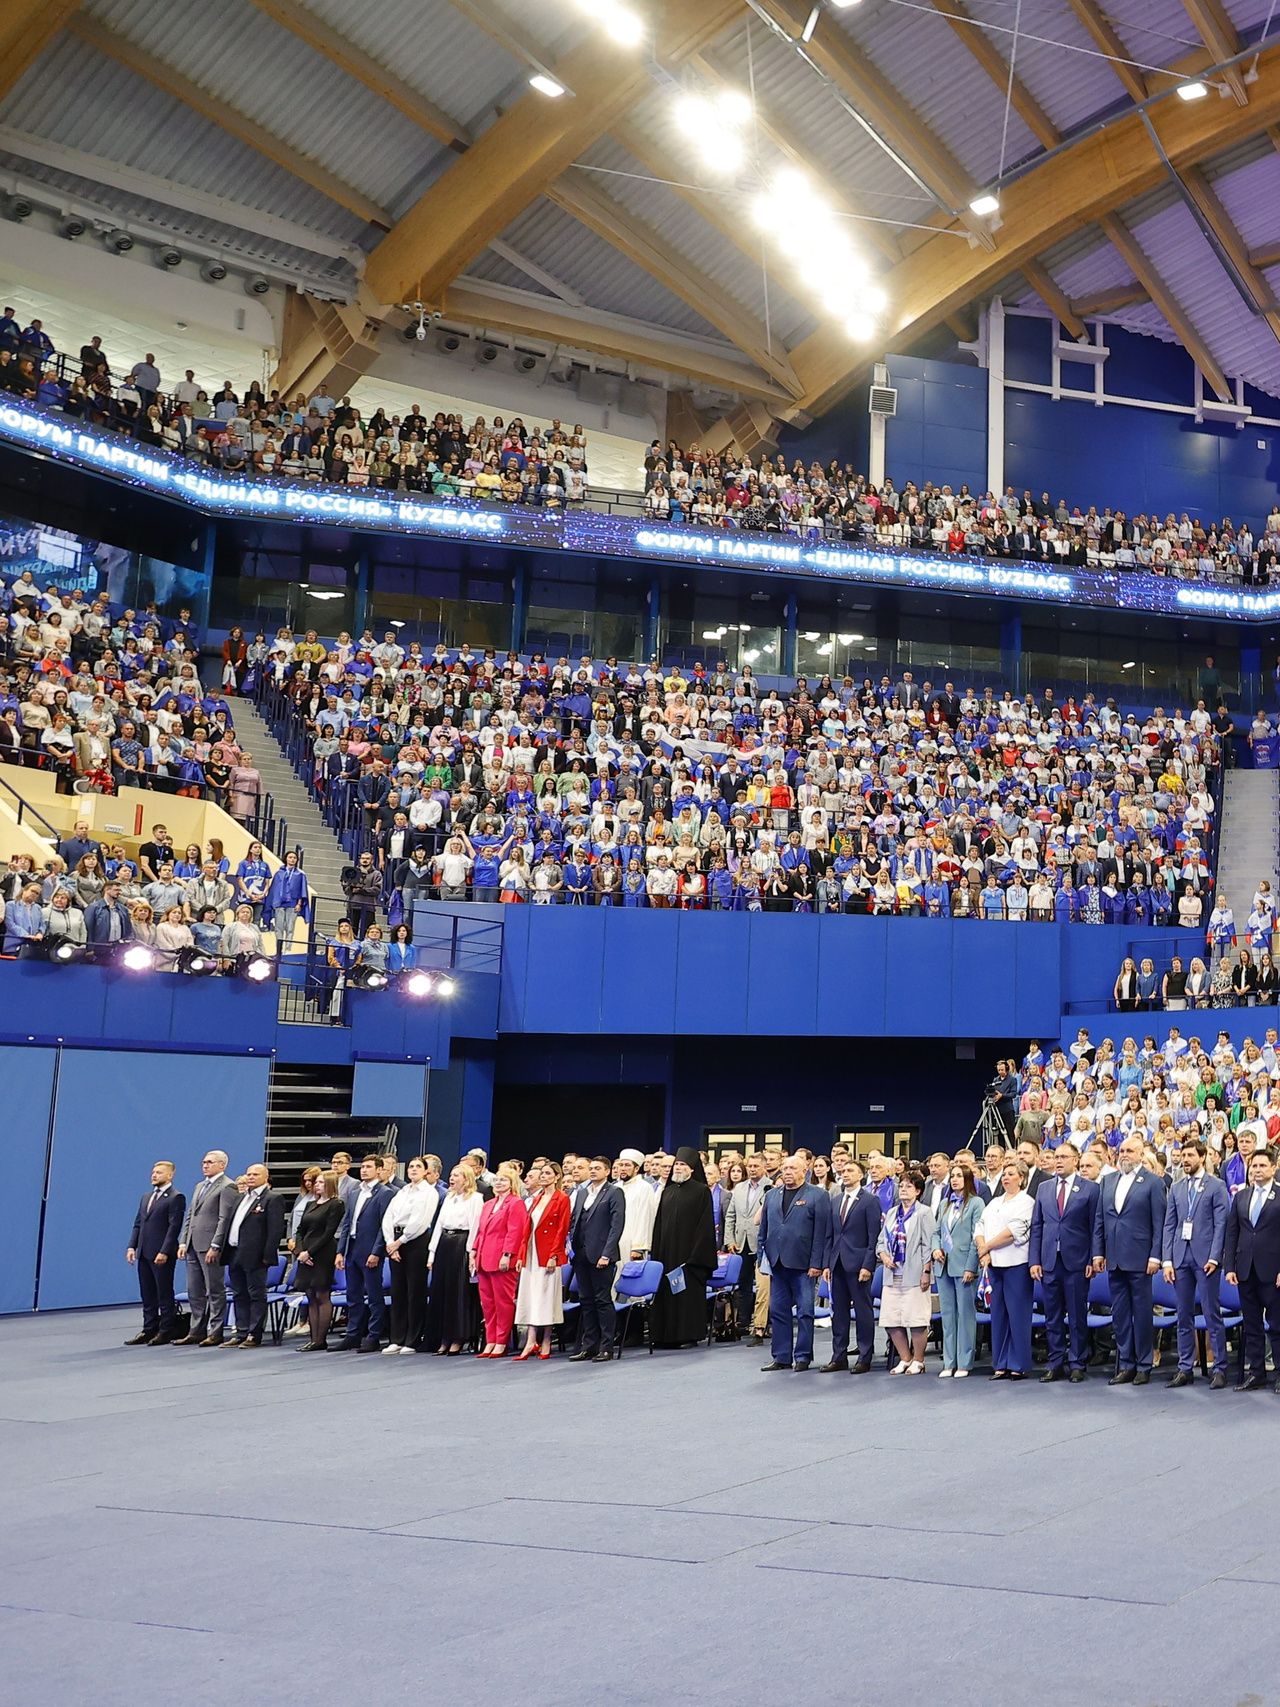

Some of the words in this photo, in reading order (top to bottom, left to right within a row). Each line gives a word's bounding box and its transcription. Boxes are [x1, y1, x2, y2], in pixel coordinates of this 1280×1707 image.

[78, 435, 168, 480] ПАРТИИ
[172, 474, 278, 504] «ЕДИНАЯ
[285, 493, 392, 517] РОССИЯ»
[399, 505, 502, 529] КУZБАСС
[636, 530, 713, 553] ФОРУМ
[718, 540, 800, 562] ПАРТИИ
[803, 550, 895, 571] «ЕДИНАЯ
[900, 560, 984, 580] РОССИЯ»
[988, 569, 1071, 591] КУZБАСС
[1177, 589, 1239, 608] ФОРУМ
